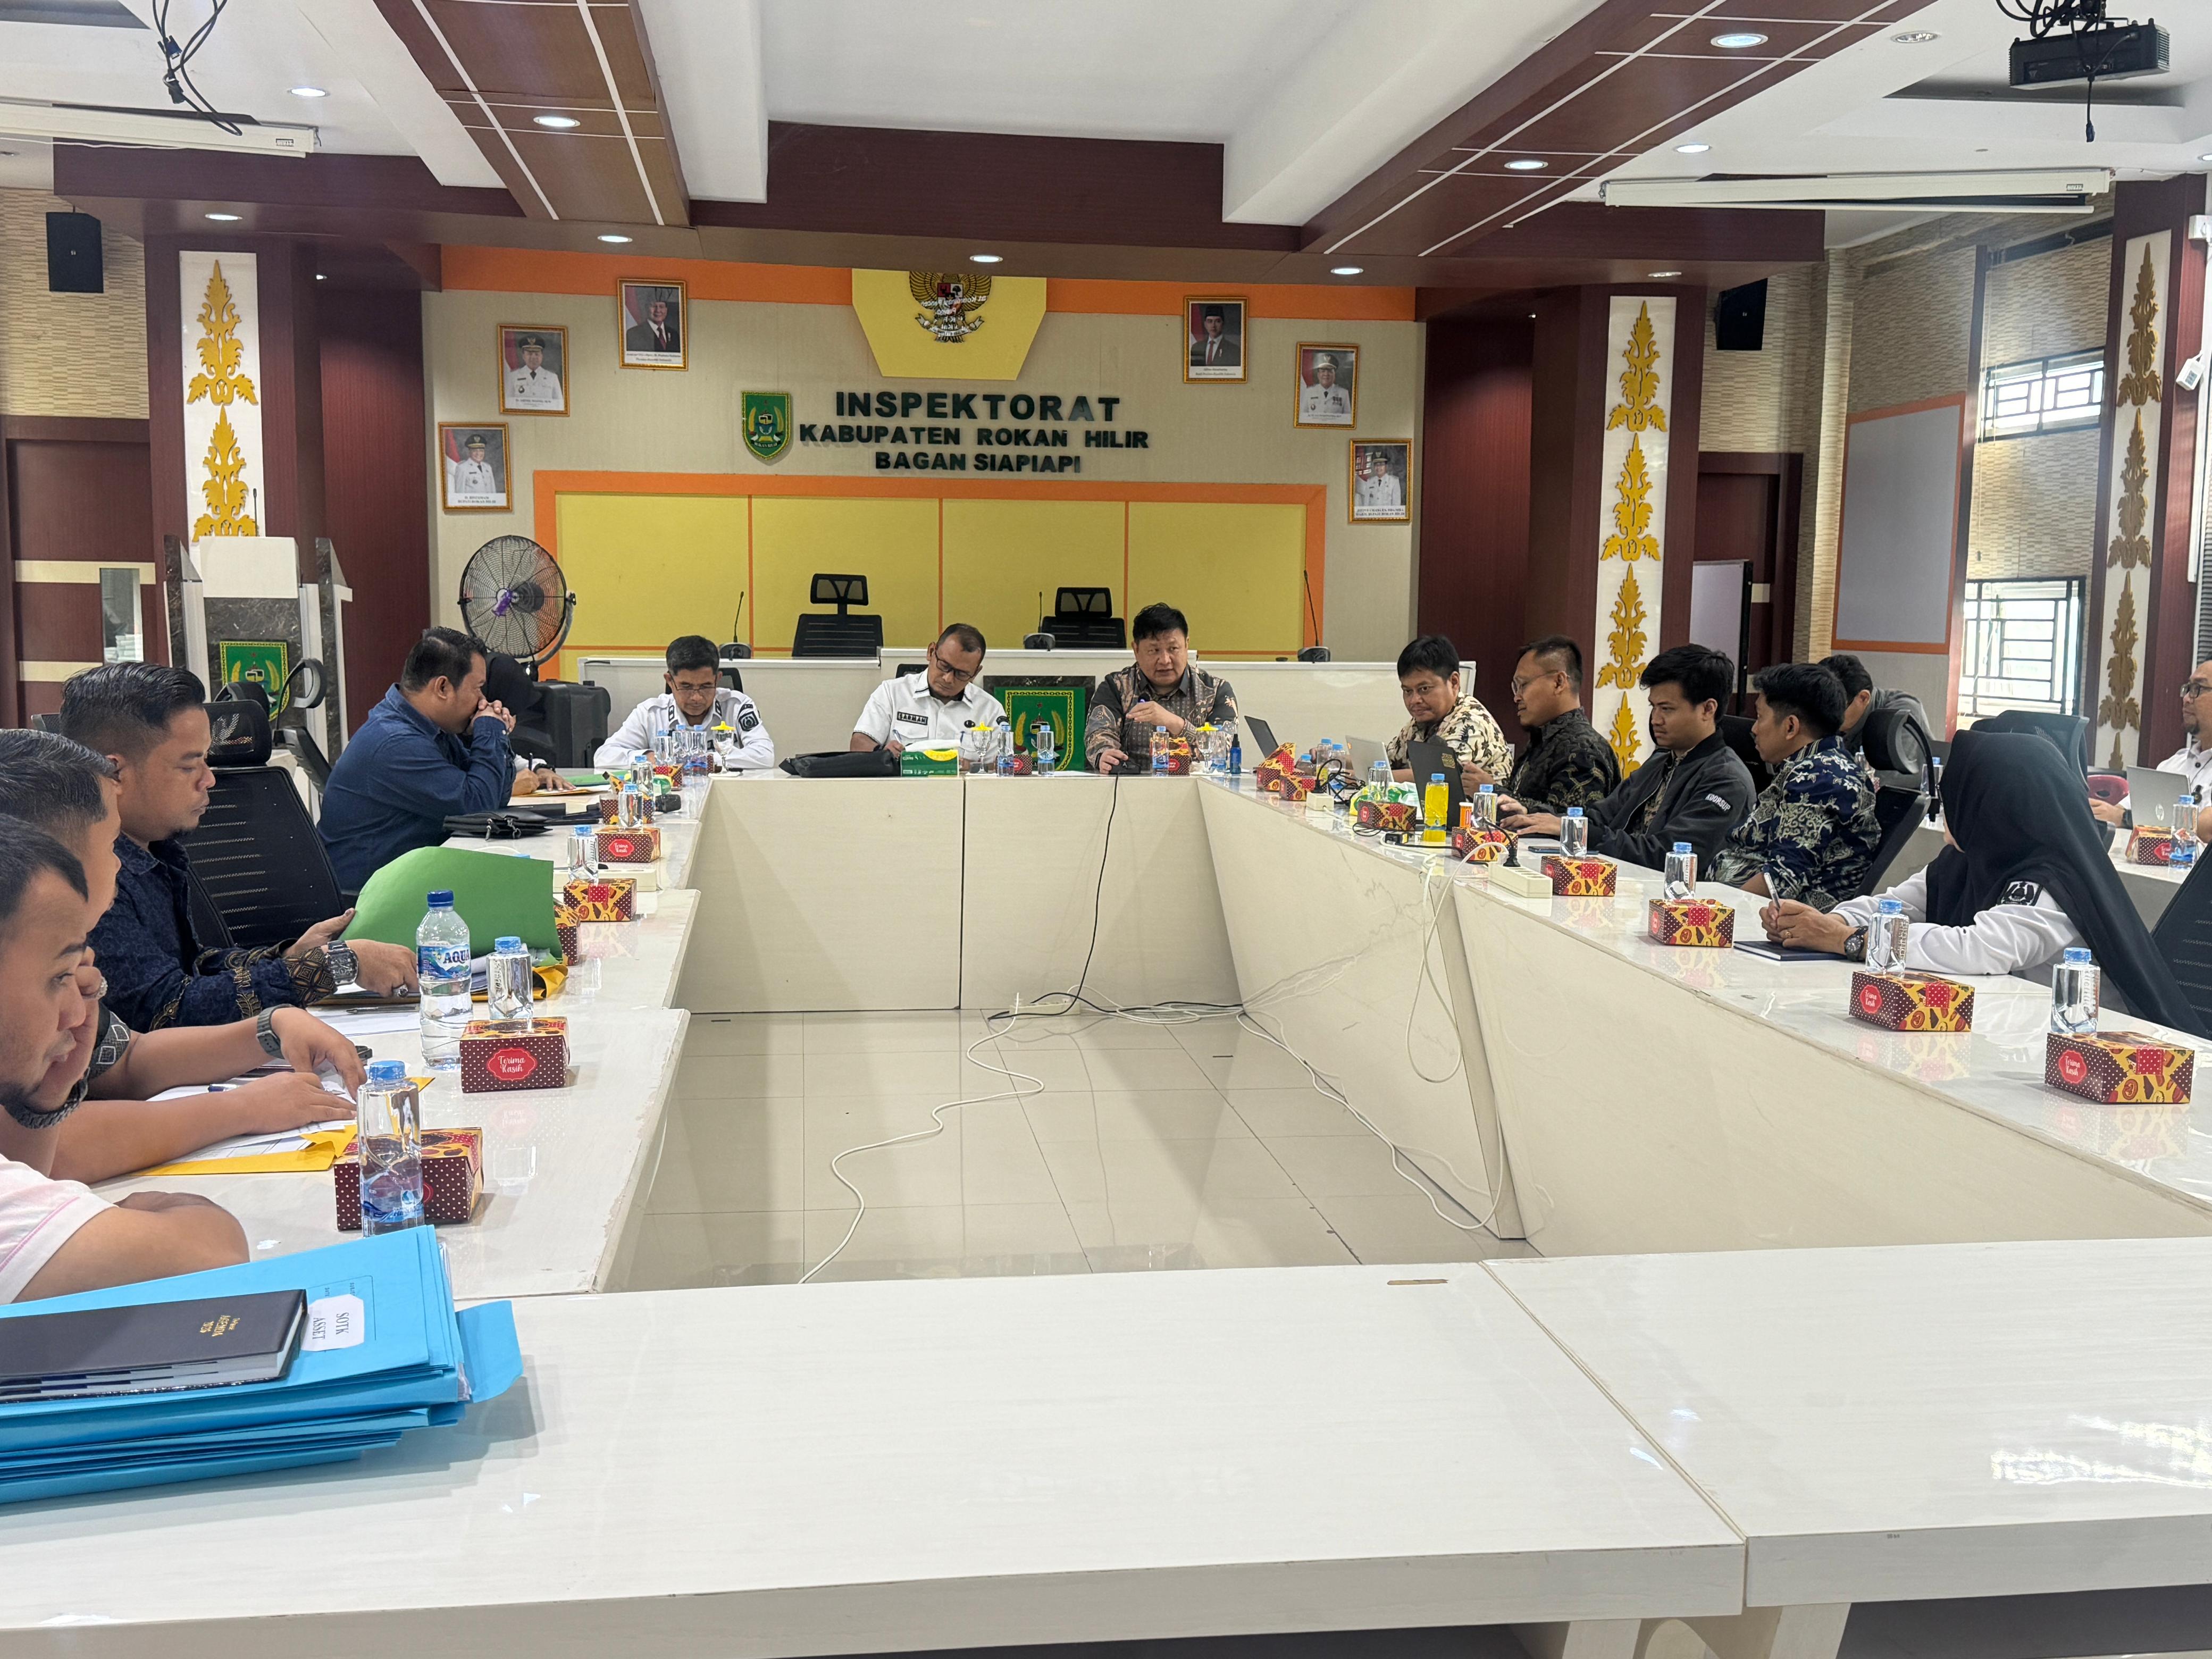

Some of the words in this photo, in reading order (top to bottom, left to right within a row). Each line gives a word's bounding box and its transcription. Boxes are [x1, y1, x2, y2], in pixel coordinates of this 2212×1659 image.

[836, 391, 1120, 422] INSPEKTORAT
[799, 424, 960, 445] KABUPATEN
[977, 428, 1067, 447] ROKAN
[1085, 430, 1149, 448] HILIR
[875, 451, 966, 471] BAGAN
[974, 454, 1080, 473] SIAPIAPI
[899, 713, 925, 724] SARMAN
[1705, 793, 1731, 811] KOORSUP
[442, 949, 470, 964] AQUA
[498, 1055, 526, 1065] Terima
[500, 1063, 524, 1073] Kasih
[2064, 1055, 2081, 1068] Terima
[2066, 1065, 2079, 1076] Kasih
[211, 1315, 231, 1337] AGENDA
[312, 1317, 326, 1339] ASSET
[336, 1312, 349, 1335] SOTK
